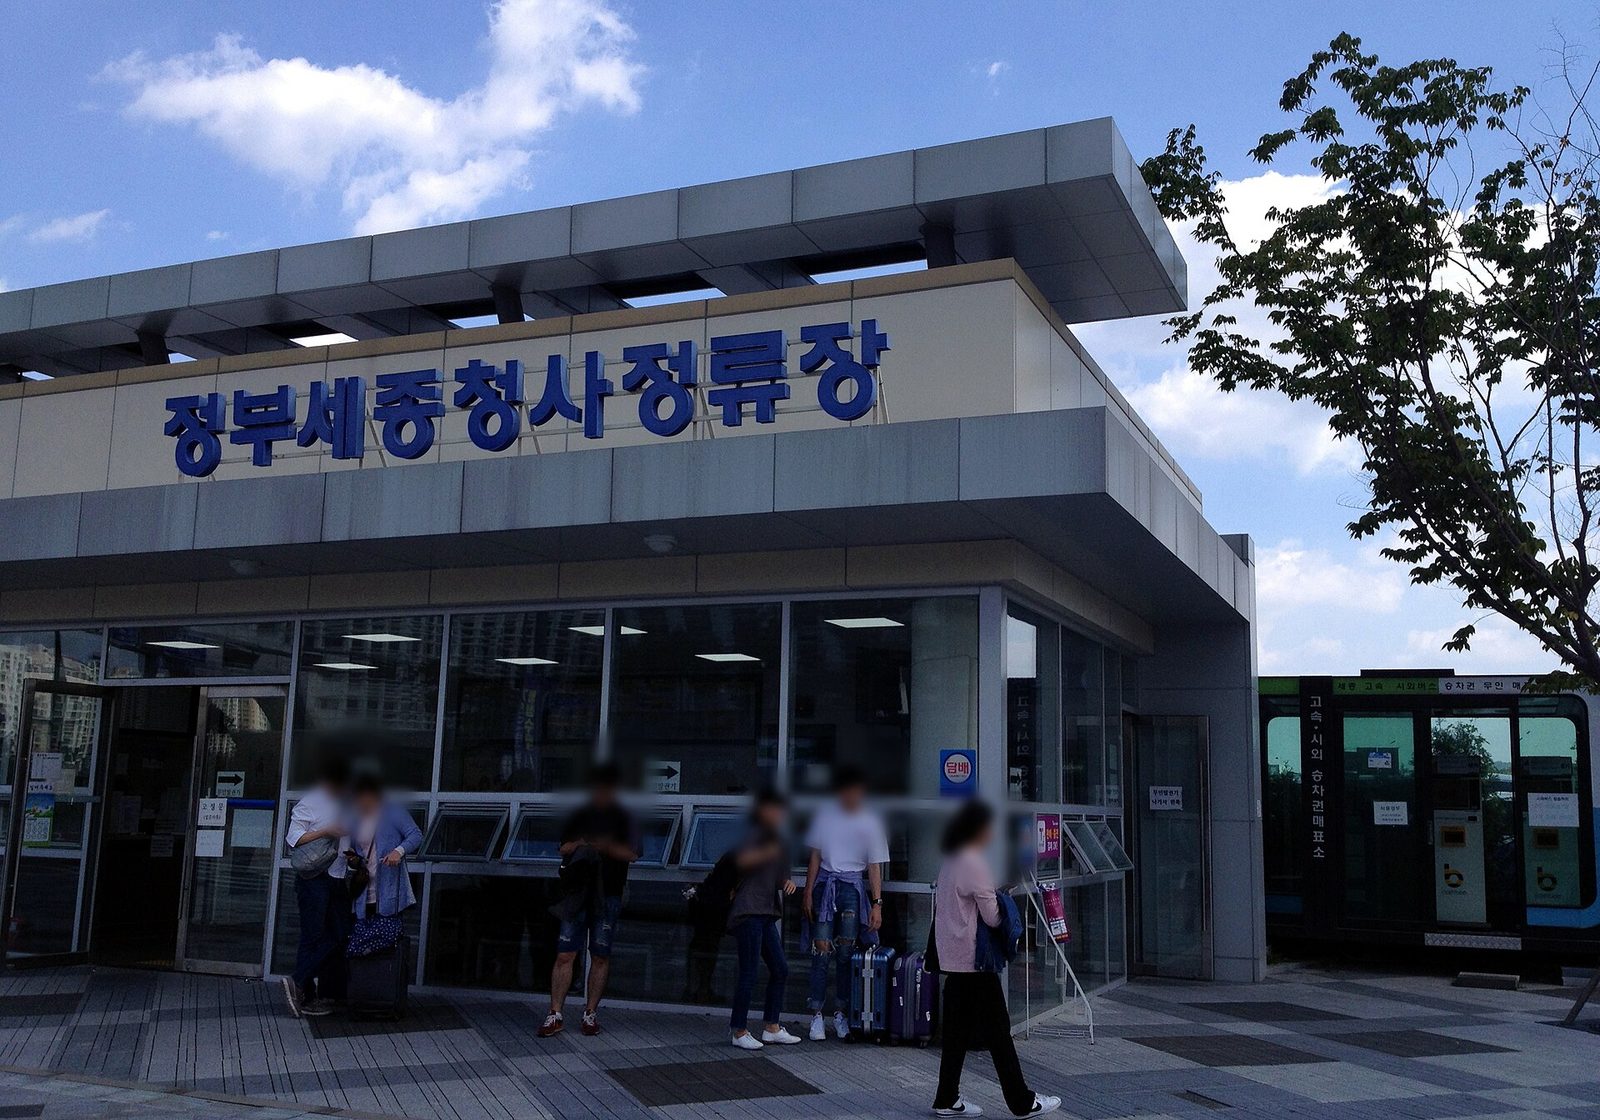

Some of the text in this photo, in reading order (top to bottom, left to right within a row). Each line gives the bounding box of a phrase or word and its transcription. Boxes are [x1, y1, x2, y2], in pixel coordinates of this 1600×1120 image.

[164, 319, 890, 478] 정부세종청사정류장
[1445, 681, 1475, 691] 승차권
[1484, 681, 1504, 691] 무인
[946, 761, 969, 774] 담배
